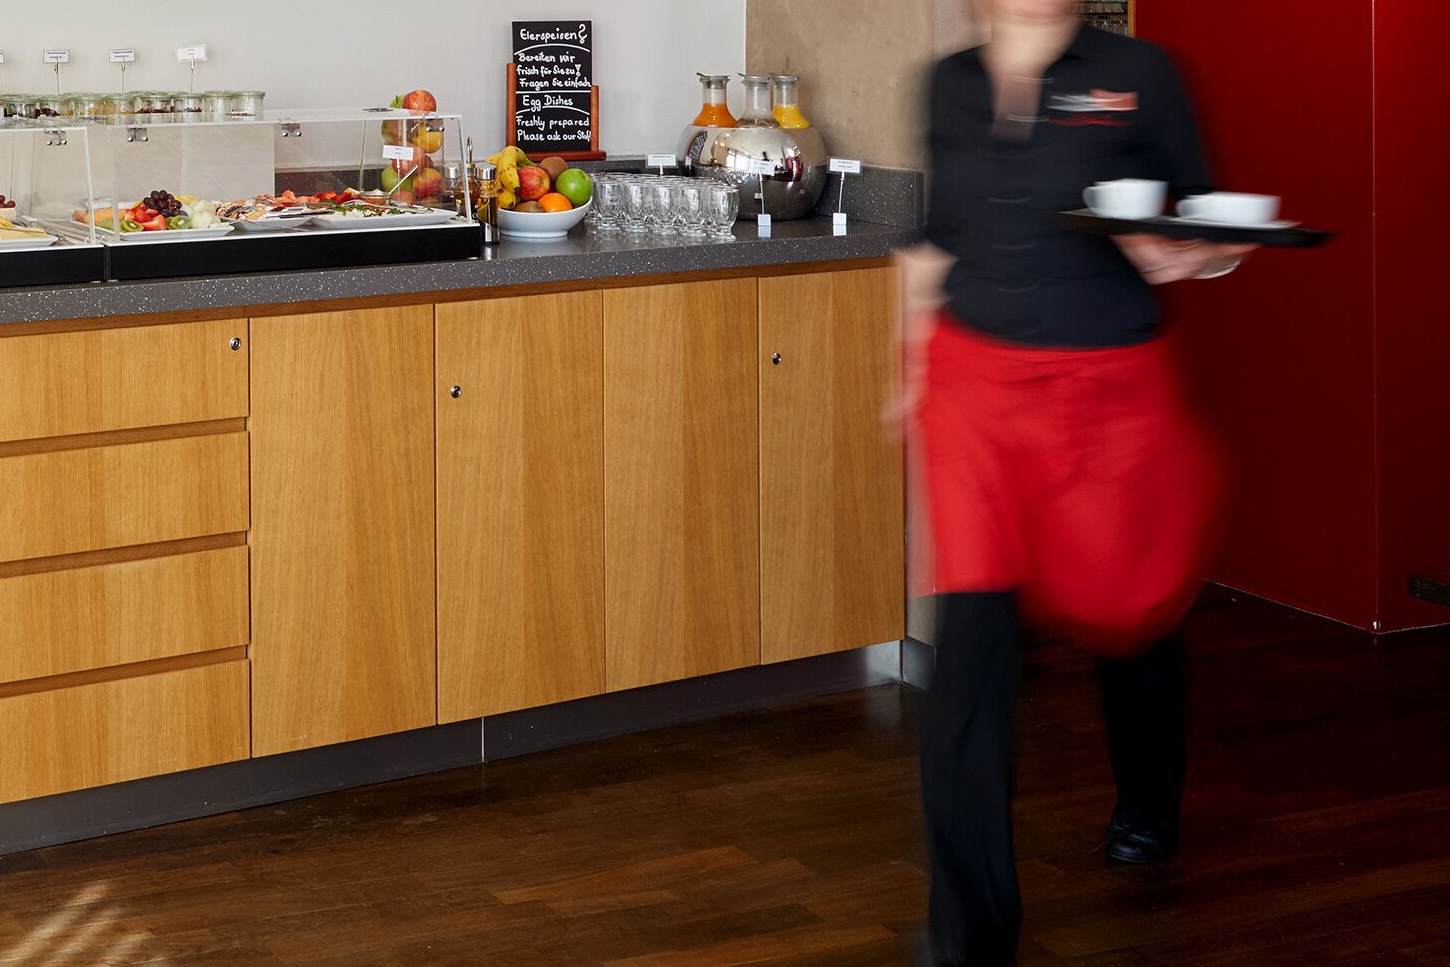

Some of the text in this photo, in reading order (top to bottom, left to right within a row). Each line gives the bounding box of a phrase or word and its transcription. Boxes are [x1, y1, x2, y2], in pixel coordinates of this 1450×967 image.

[520, 23, 588, 44] Eierspeisen?
[518, 51, 556, 62] Bereiten
[516, 64, 539, 75] frisch
[540, 65, 552, 77] für
[553, 65, 565, 75] Sie
[519, 77, 592, 91] Fragen Sie einfach
[522, 94, 573, 112] Egg Dishes
[516, 115, 590, 131] Freshly prepared
[517, 129, 545, 141] Please
[546, 130, 561, 141] ask
[562, 133, 576, 141] our
